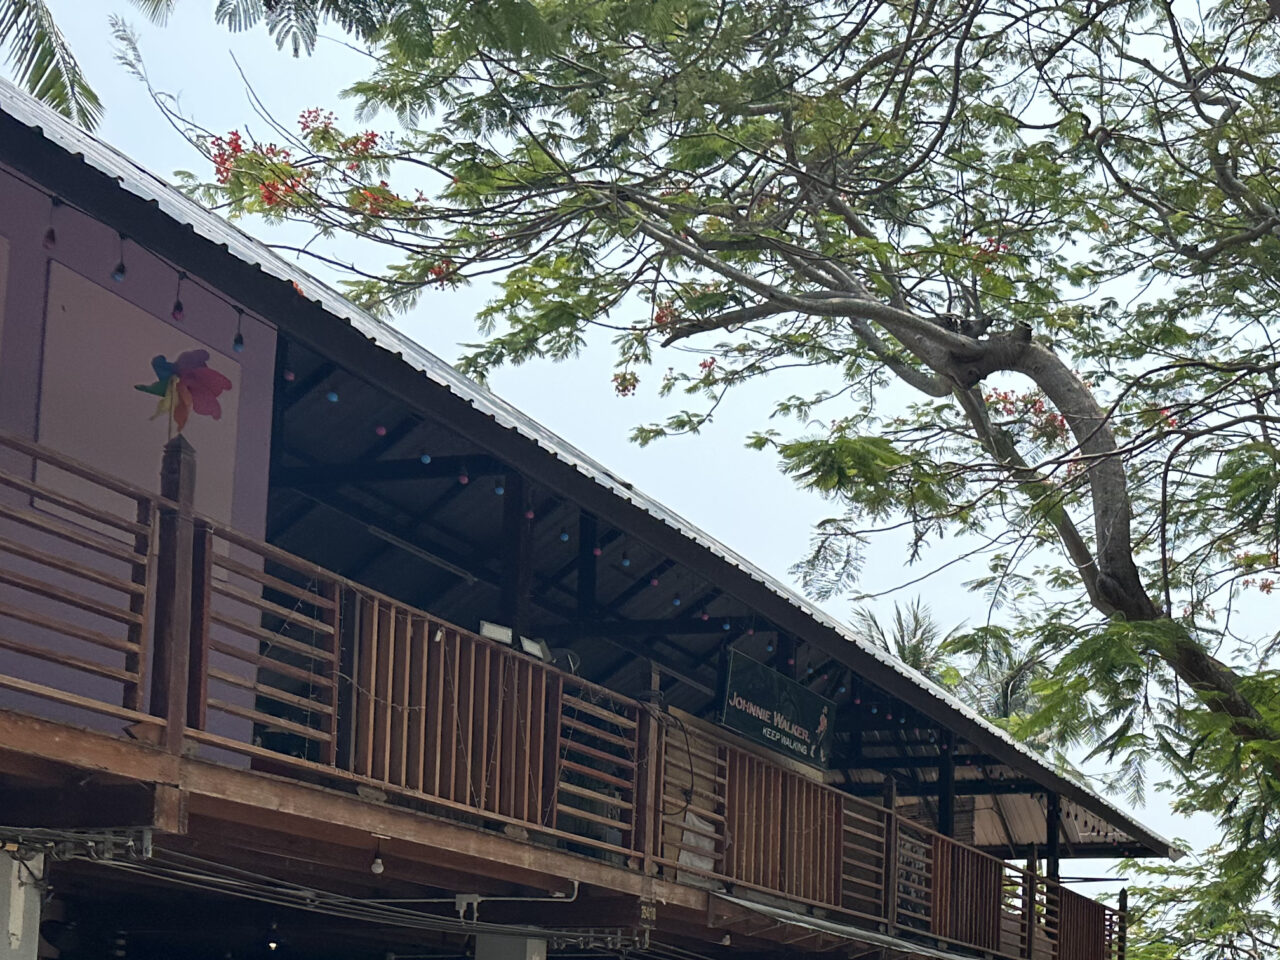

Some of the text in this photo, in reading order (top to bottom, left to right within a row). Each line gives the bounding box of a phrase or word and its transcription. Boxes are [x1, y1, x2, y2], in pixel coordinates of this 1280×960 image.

[729, 692, 771, 723] JOHNNIE
[762, 726, 808, 755] KEEP WALKING
